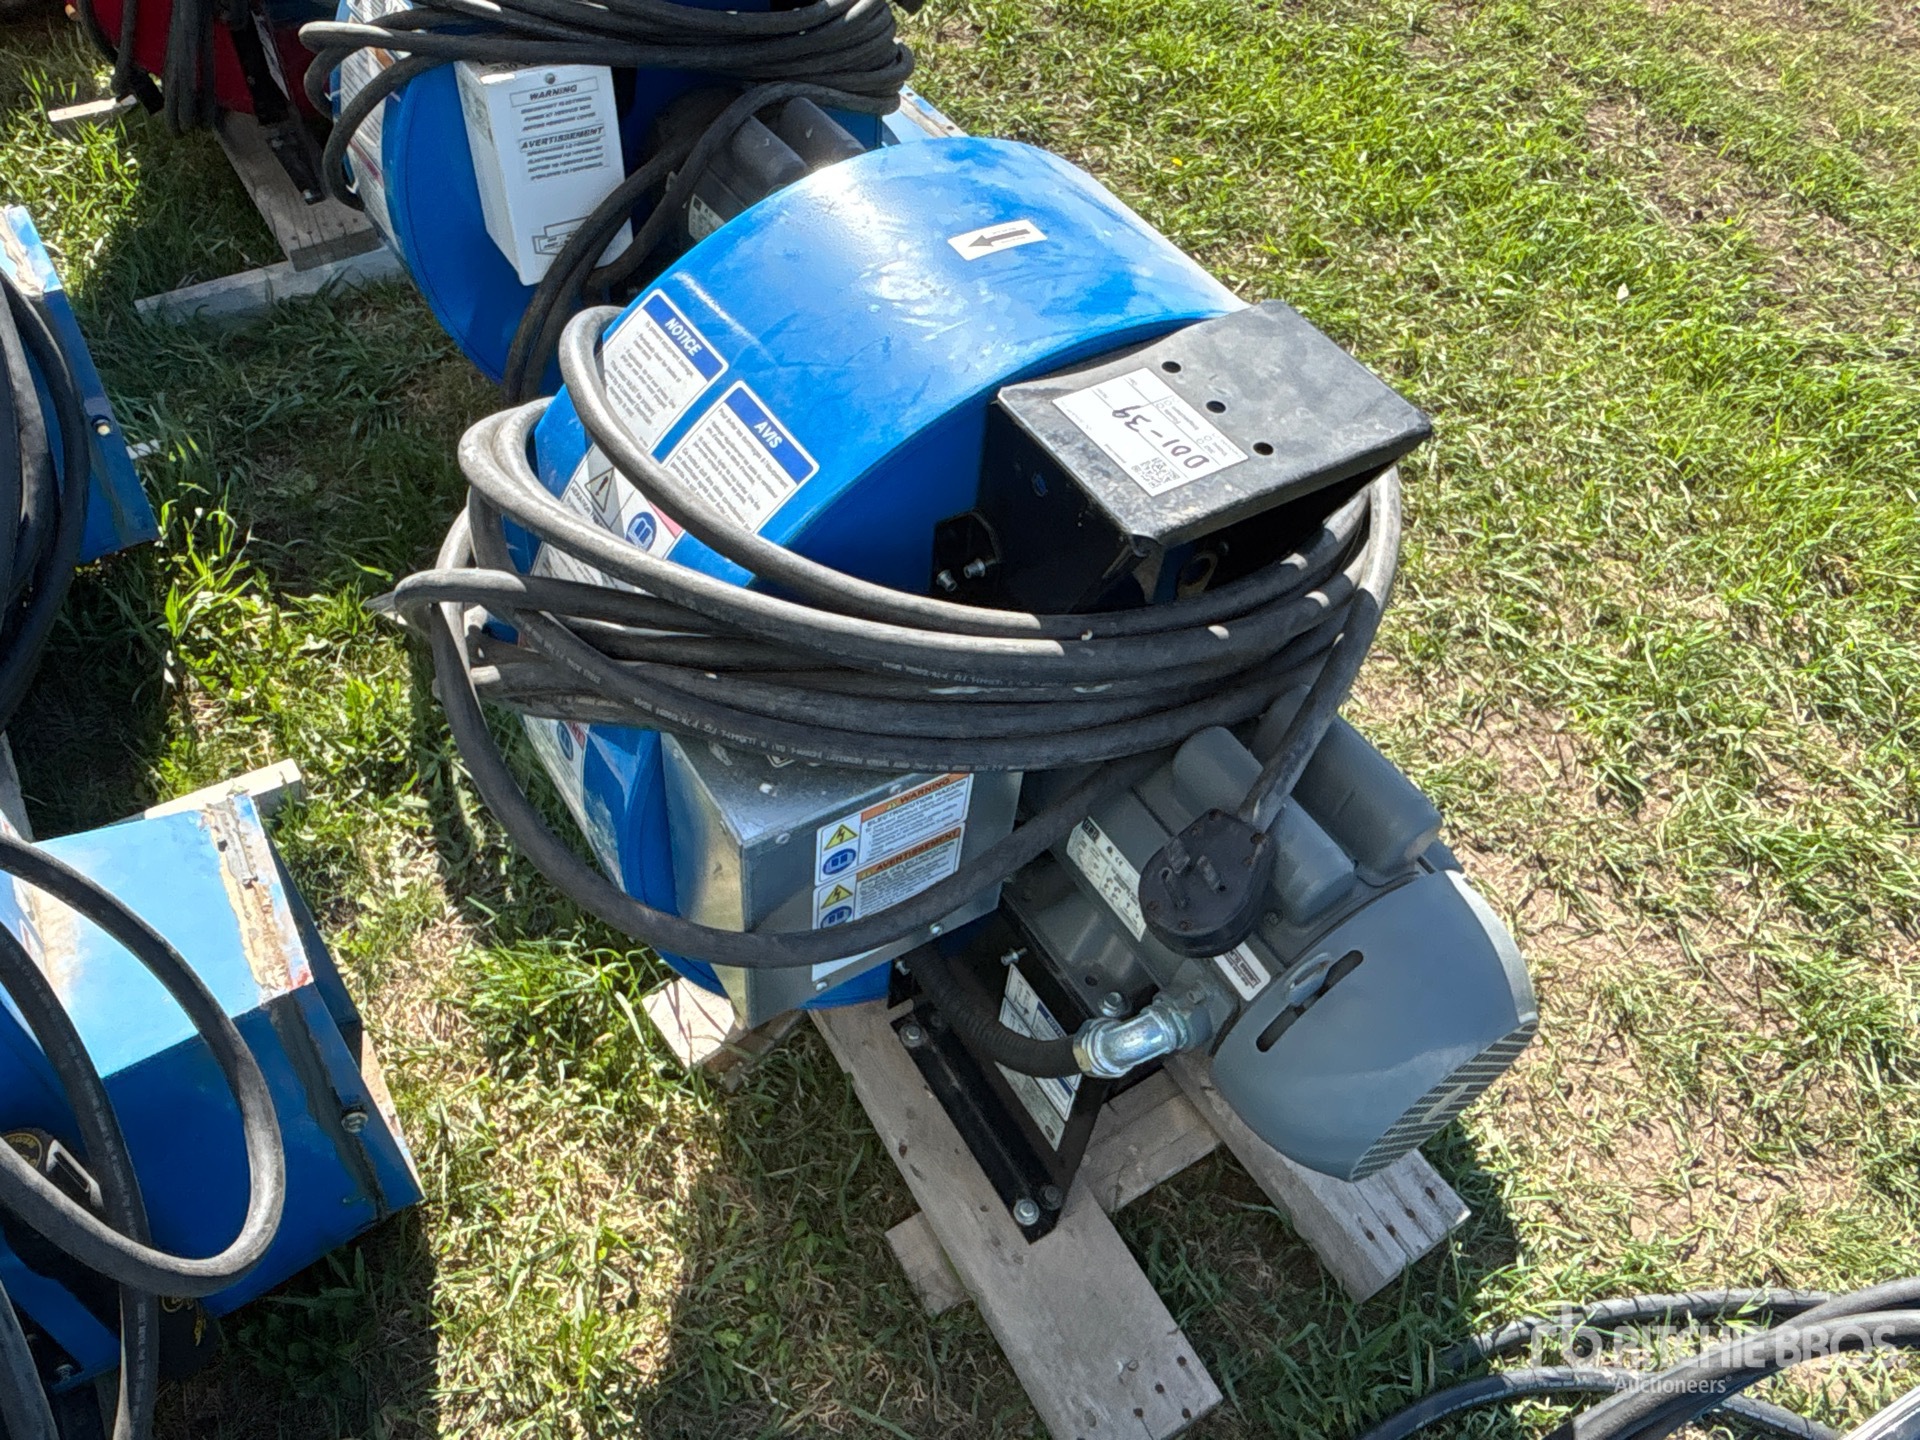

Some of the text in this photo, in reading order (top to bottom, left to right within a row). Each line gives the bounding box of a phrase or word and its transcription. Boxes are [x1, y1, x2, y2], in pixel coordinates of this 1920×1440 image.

[529, 84, 578, 101] WARNING
[520, 126, 605, 150] AVERTISSEMENT
[664, 317, 703, 357] NOTICE
[753, 420, 783, 449] AVIS
[899, 777, 951, 804] WARNING
